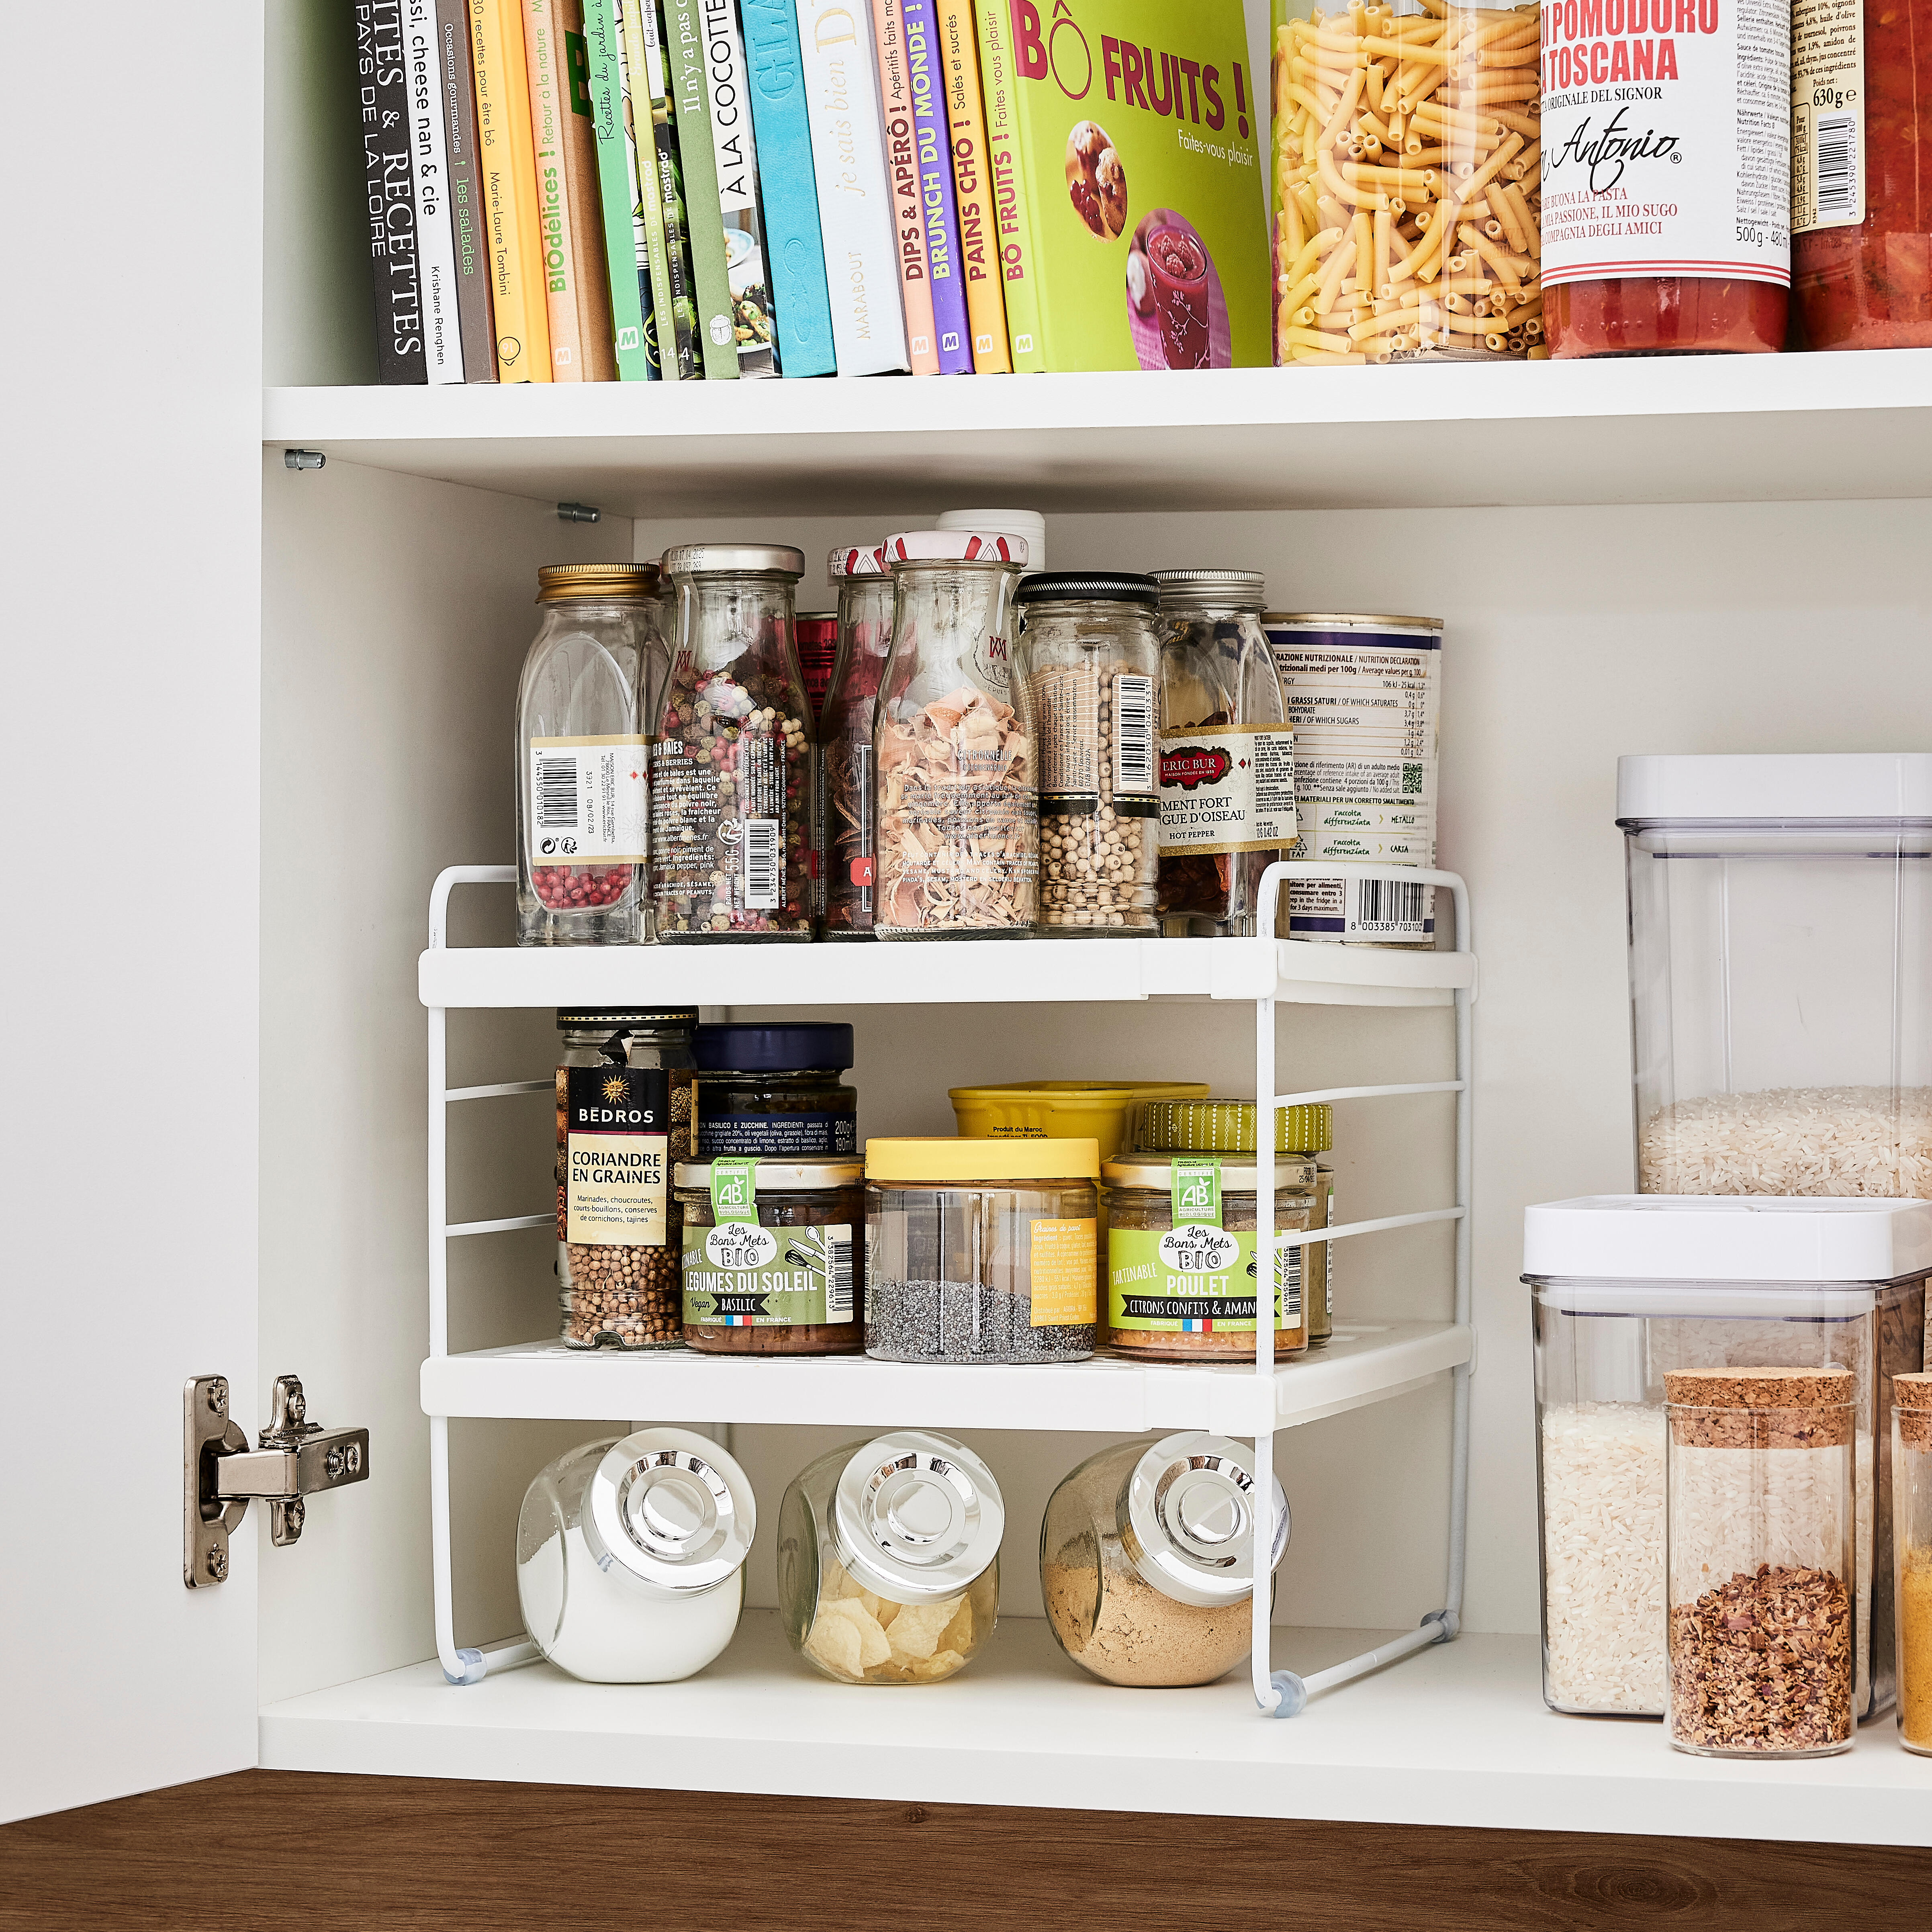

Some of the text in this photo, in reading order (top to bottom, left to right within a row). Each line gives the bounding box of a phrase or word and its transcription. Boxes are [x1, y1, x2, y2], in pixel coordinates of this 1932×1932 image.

[1832, 0, 1856, 10] oignons
[1553, 0, 1719, 43] POMODORO
[1820, 12, 1856, 22] huile d'olive
[1830, 24, 1856, 36] poivrons
[537, 28, 548, 69] nature
[1824, 37, 1844, 47] amidon
[678, 13, 702, 114] Il n'y pas
[1010, 0, 1225, 131] BÔ FRUITS
[1549, 39, 1678, 91] TOSCANA
[445, 23, 461, 153] Occasions gourmandes
[475, 20, 495, 146] recettes pour être bô
[536, 74, 549, 87] la
[591, 13, 616, 145] Recettes du jardin
[705, 0, 746, 196] À LA COCOTTE
[1548, 86, 1663, 110] ORIGINALE DEL SIGNOR
[356, 5, 386, 257] PAYS DE LA LOIRE
[412, 36, 439, 215] cheese nan cie
[543, 104, 554, 144] Retour
[825, 59, 865, 197] je sais bien
[884, 21, 923, 280] DIPS APÉRÔ Apéritifs faits
[917, 127, 938, 165] DU
[945, 14, 987, 282] PAINS CHÔ Salés sucrés
[985, 11, 1024, 281] BÔ FRUITS Faites vous plaisir
[1178, 129, 1253, 166] Faites-vous plaisir
[1552, 106, 1680, 194] Antonio
[1552, 187, 1628, 207] BUONA LA PASTA
[1554, 204, 1677, 223] PASSIONE, IL MIO SUGO
[456, 178, 474, 275] les salades
[490, 172, 510, 295] Marie-Laure Tombini
[658, 151, 681, 298] INDISPENSABLES mastrad
[922, 172, 950, 280] BRUNCH
[1546, 221, 1662, 244] COMPAGNIA DEGLI AMICI
[383, 149, 421, 355] RECETTES
[848, 252, 871, 340] MARABOUT
[431, 266, 444, 365] Krishane Renghen
[1305, 654, 1353, 662] NUTRIZIONALE
[663, 740, 683, 755] BAIES
[957, 750, 1012, 761] CITRONNELLE
[665, 758, 693, 766] BERRIES
[963, 763, 1007, 772] CITROENKRUID
[1163, 758, 1216, 771] ERIC BUR
[1199, 797, 1232, 809] FORT
[1190, 810, 1245, 823] D'OISEAU
[1324, 818, 1370, 826] differenziata
[1188, 830, 1215, 838] PEPPER
[724, 849, 740, 871] 55G
[1323, 848, 1370, 856] differenziata
[1362, 922, 1395, 931] 003385
[572, 1151, 661, 1167] CORIANDRE
[572, 1168, 661, 1184] EN GRAINES
[574, 1205, 623, 1214] courts-bouillons,
[577, 1195, 653, 1204] Marinades, choucroutes,
[588, 1215, 625, 1223] cornichons,
[1034, 1222, 1081, 1233] Graines de pavot
[728, 1223, 748, 1236] Les
[710, 1235, 769, 1246] Bons Mets
[1164, 1237, 1232, 1249] Bons Mets
[721, 1248, 759, 1267] BIO
[1178, 1250, 1221, 1270] BIO
[685, 1271, 818, 1292] LEGUMES DU SOLEIL
[1112, 1262, 1158, 1286] TARTINABLE
[1167, 1275, 1229, 1296] POULET
[690, 1297, 711, 1311] Vegan
[722, 1298, 756, 1312] BASILIC
[1130, 1299, 1209, 1315] CITRONS CONFITS
